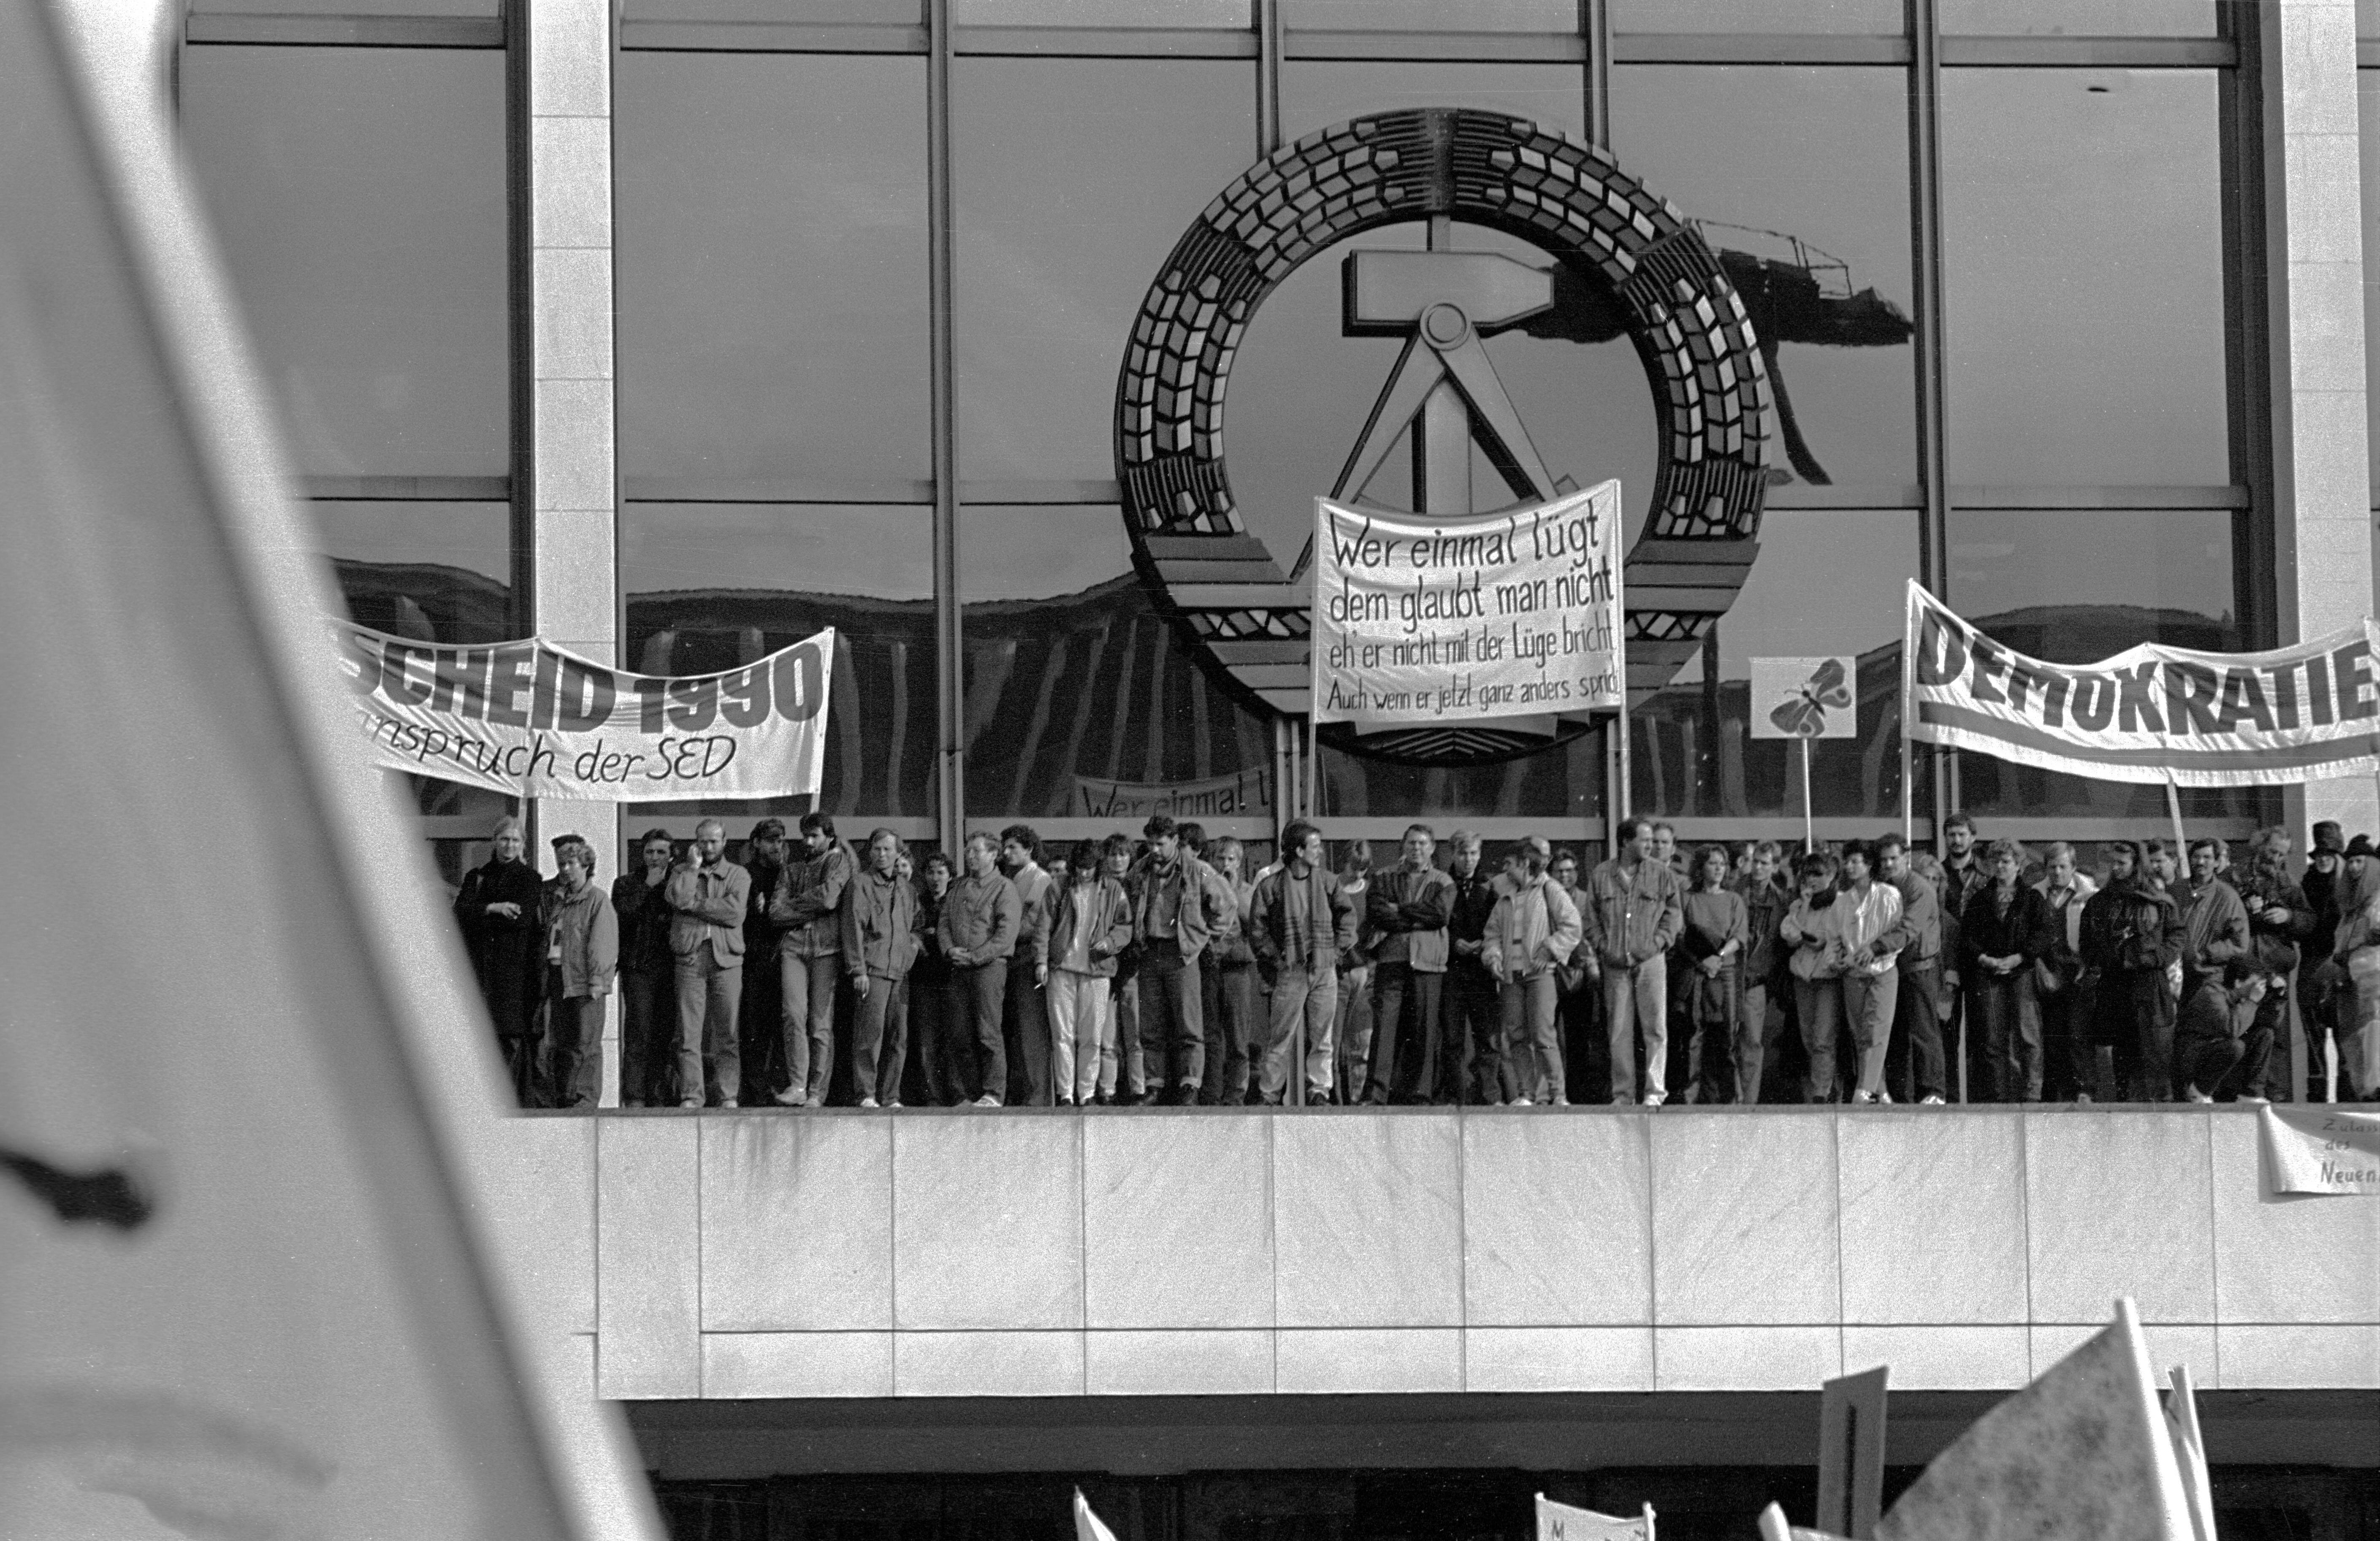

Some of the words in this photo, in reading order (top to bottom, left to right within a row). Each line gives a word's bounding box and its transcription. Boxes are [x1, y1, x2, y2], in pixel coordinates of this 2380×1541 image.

[1330, 513, 1401, 568] Wer
[1410, 517, 1518, 568] einmal
[1533, 499, 1599, 567] lügt
[1330, 577, 1389, 622] dem
[1401, 571, 1485, 634] glaubt
[1496, 577, 1547, 615] man
[1556, 555, 1615, 609] nicht
[1362, 638, 1385, 666] er
[1393, 631, 1441, 666] nicht
[1445, 628, 1469, 664] mit
[1477, 625, 1506, 662] der
[1513, 622, 1557, 669] Lüge
[1563, 609, 1616, 655] bricht
[1916, 605, 2379, 735] DEMOKRATIE
[634, 642, 824, 734] 1990
[1326, 679, 1368, 710] Auch
[1374, 691, 1410, 710] wenn
[1416, 690, 1431, 707] er
[1436, 673, 1472, 714] jetzt
[1480, 685, 1513, 712] ganz
[1520, 672, 1570, 704] anders
[575, 739, 645, 784] der
[645, 735, 737, 780] SED
[2321, 1161, 2376, 1184] Neuen
